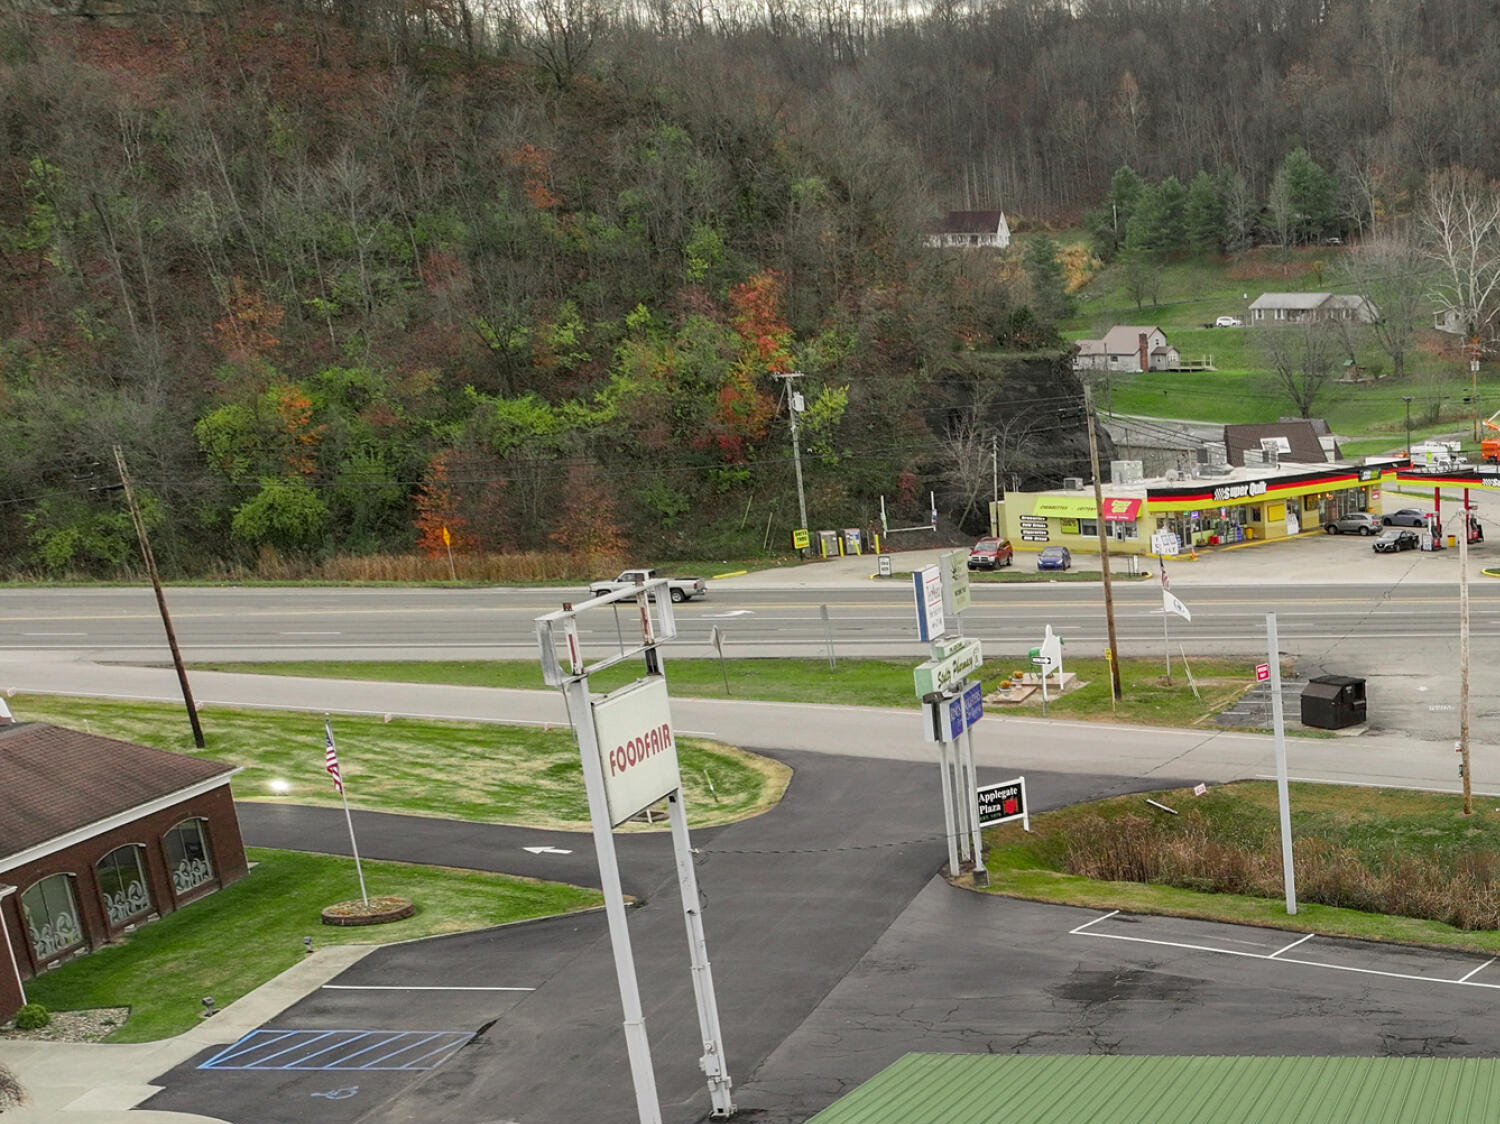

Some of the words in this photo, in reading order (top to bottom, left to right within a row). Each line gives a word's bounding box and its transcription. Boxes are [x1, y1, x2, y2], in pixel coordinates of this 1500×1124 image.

[1224, 486, 1249, 500] Super
[609, 723, 671, 776] FOODFAIR
[979, 787, 1018, 803] Applegate
[980, 804, 1001, 815] Plaza
